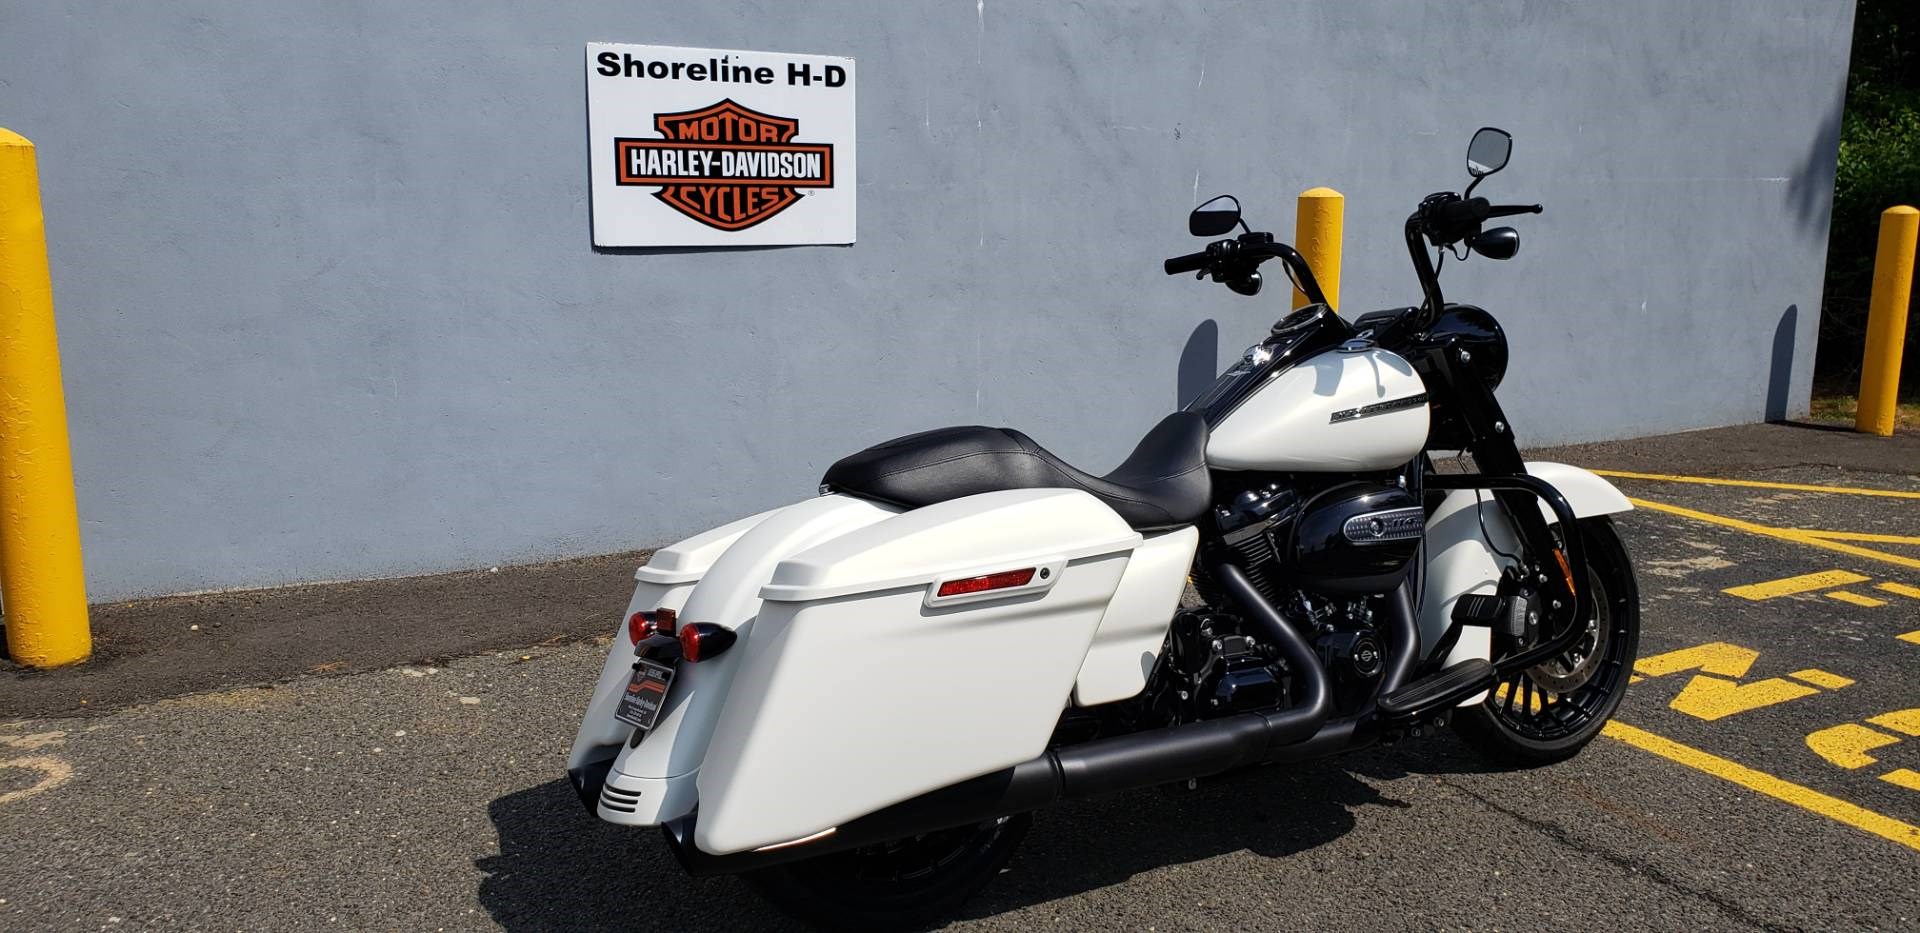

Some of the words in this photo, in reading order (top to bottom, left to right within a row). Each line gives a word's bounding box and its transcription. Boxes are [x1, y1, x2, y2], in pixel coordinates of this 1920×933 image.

[597, 52, 775, 84] Shoreline
[788, 63, 846, 87] H-D
[679, 111, 778, 142] MOTOR
[631, 148, 821, 178] HARLEY-DAVIDSON
[680, 186, 779, 222] CYCLES
